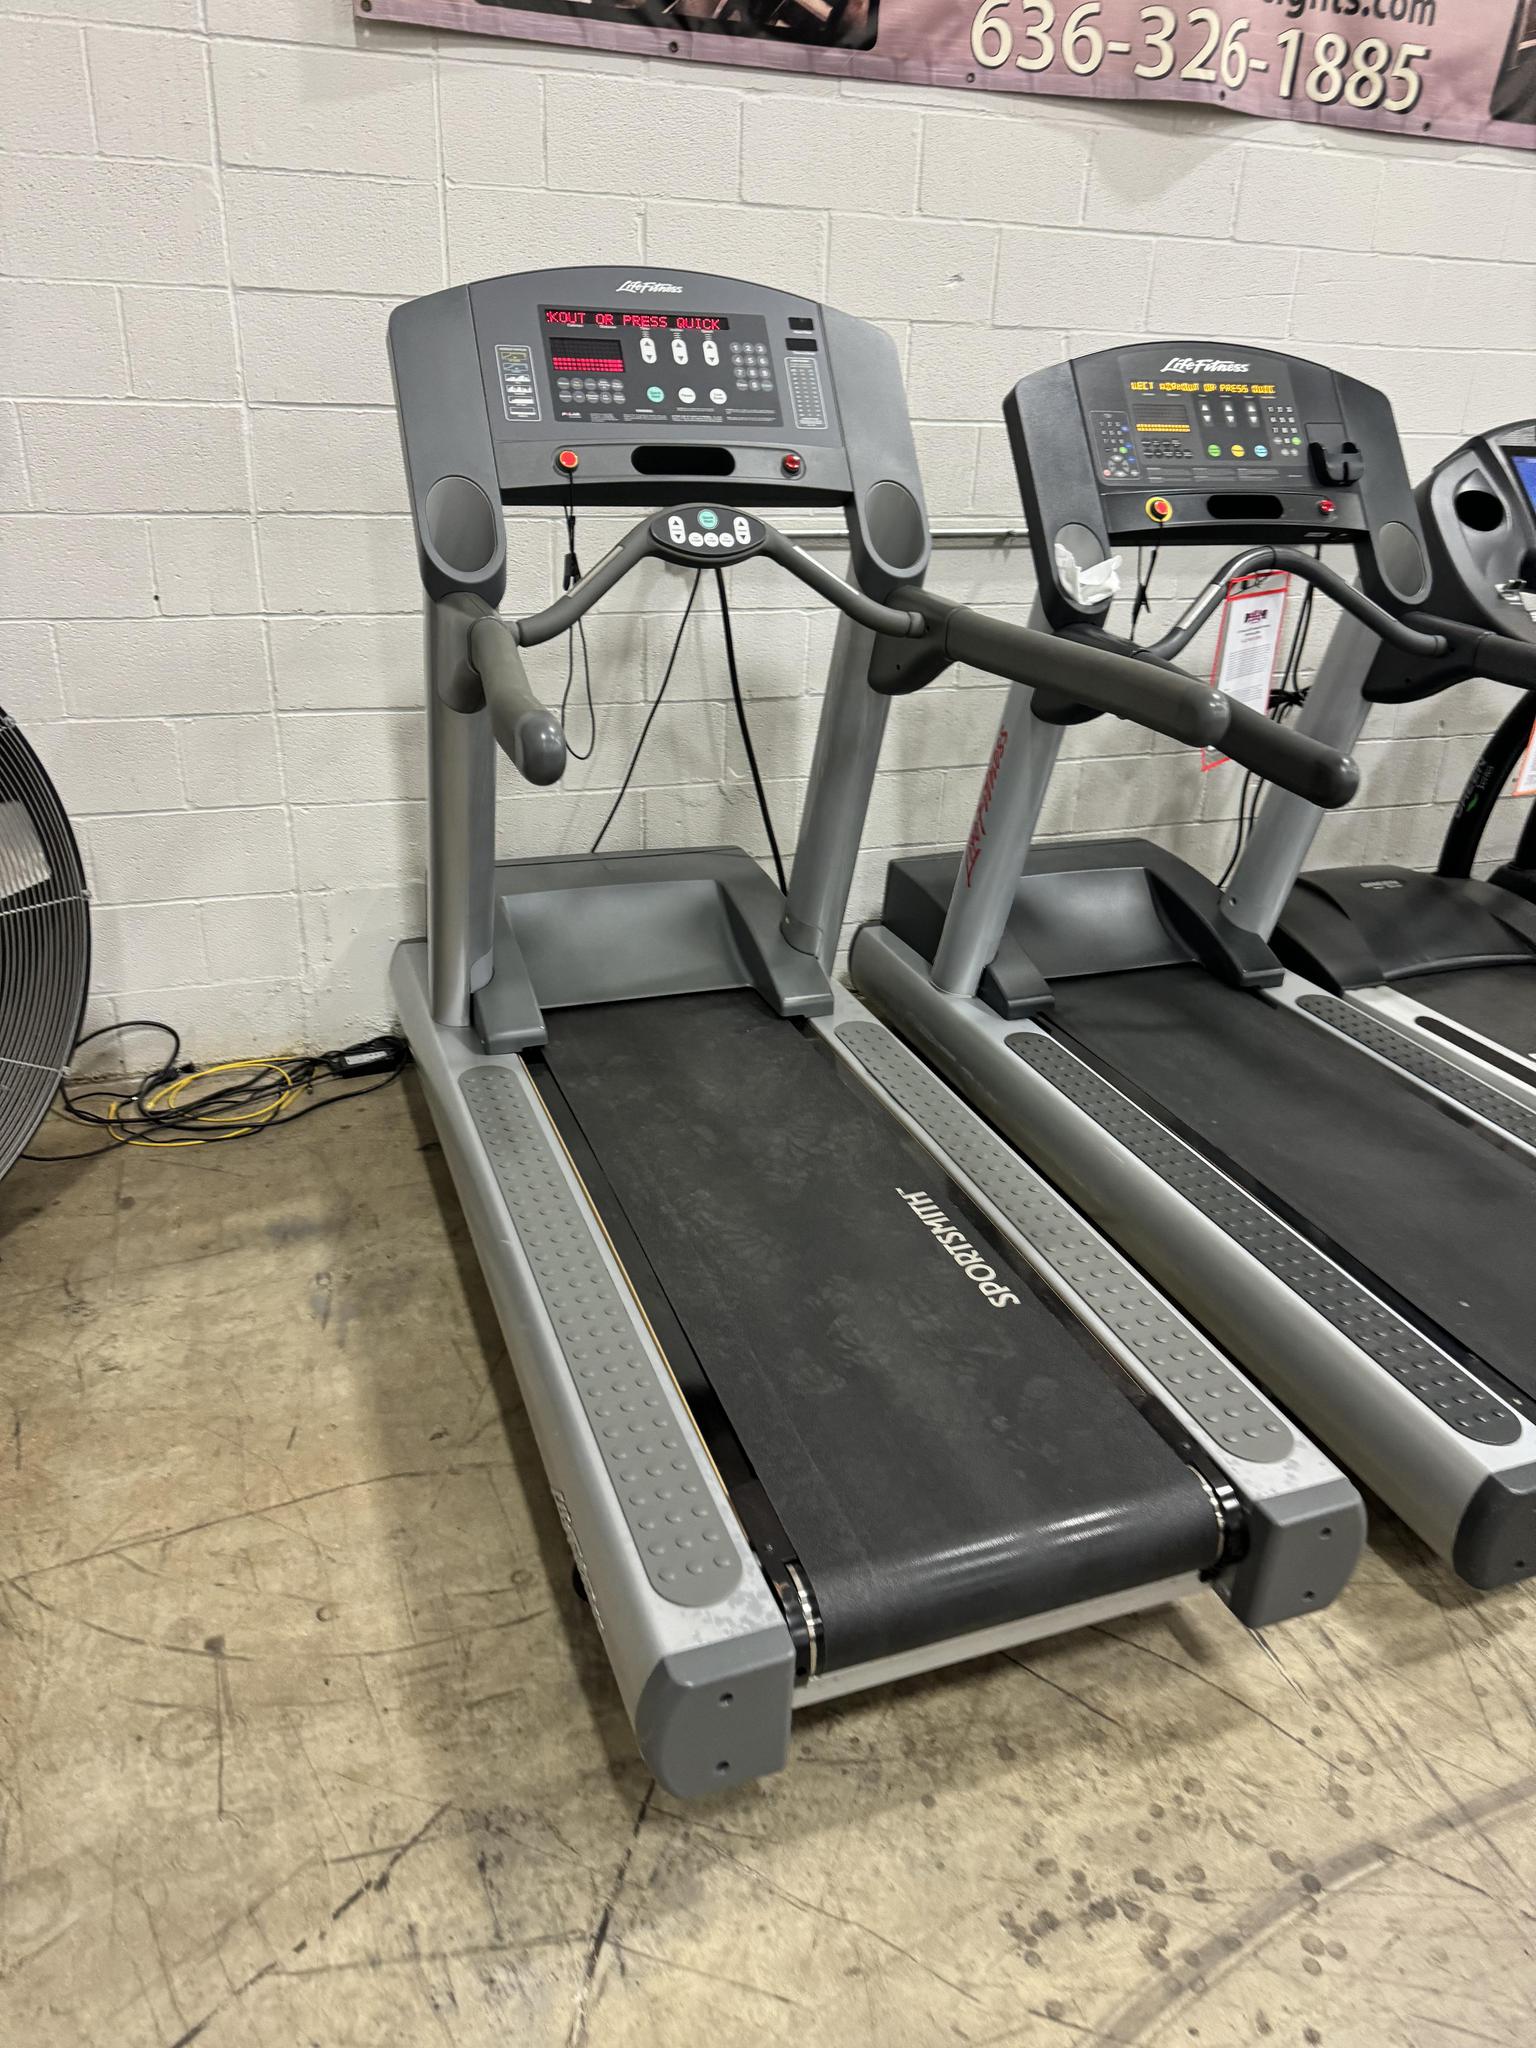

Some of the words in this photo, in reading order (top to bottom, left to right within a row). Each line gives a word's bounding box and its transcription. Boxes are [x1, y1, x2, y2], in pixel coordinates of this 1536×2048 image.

[969, 0, 1430, 114] 636-326-1885
[595, 313, 615, 326] OR
[623, 314, 667, 328] PRESS
[676, 317, 720, 331] QUICK
[900, 1190, 1021, 1308] SPORTSMITH
